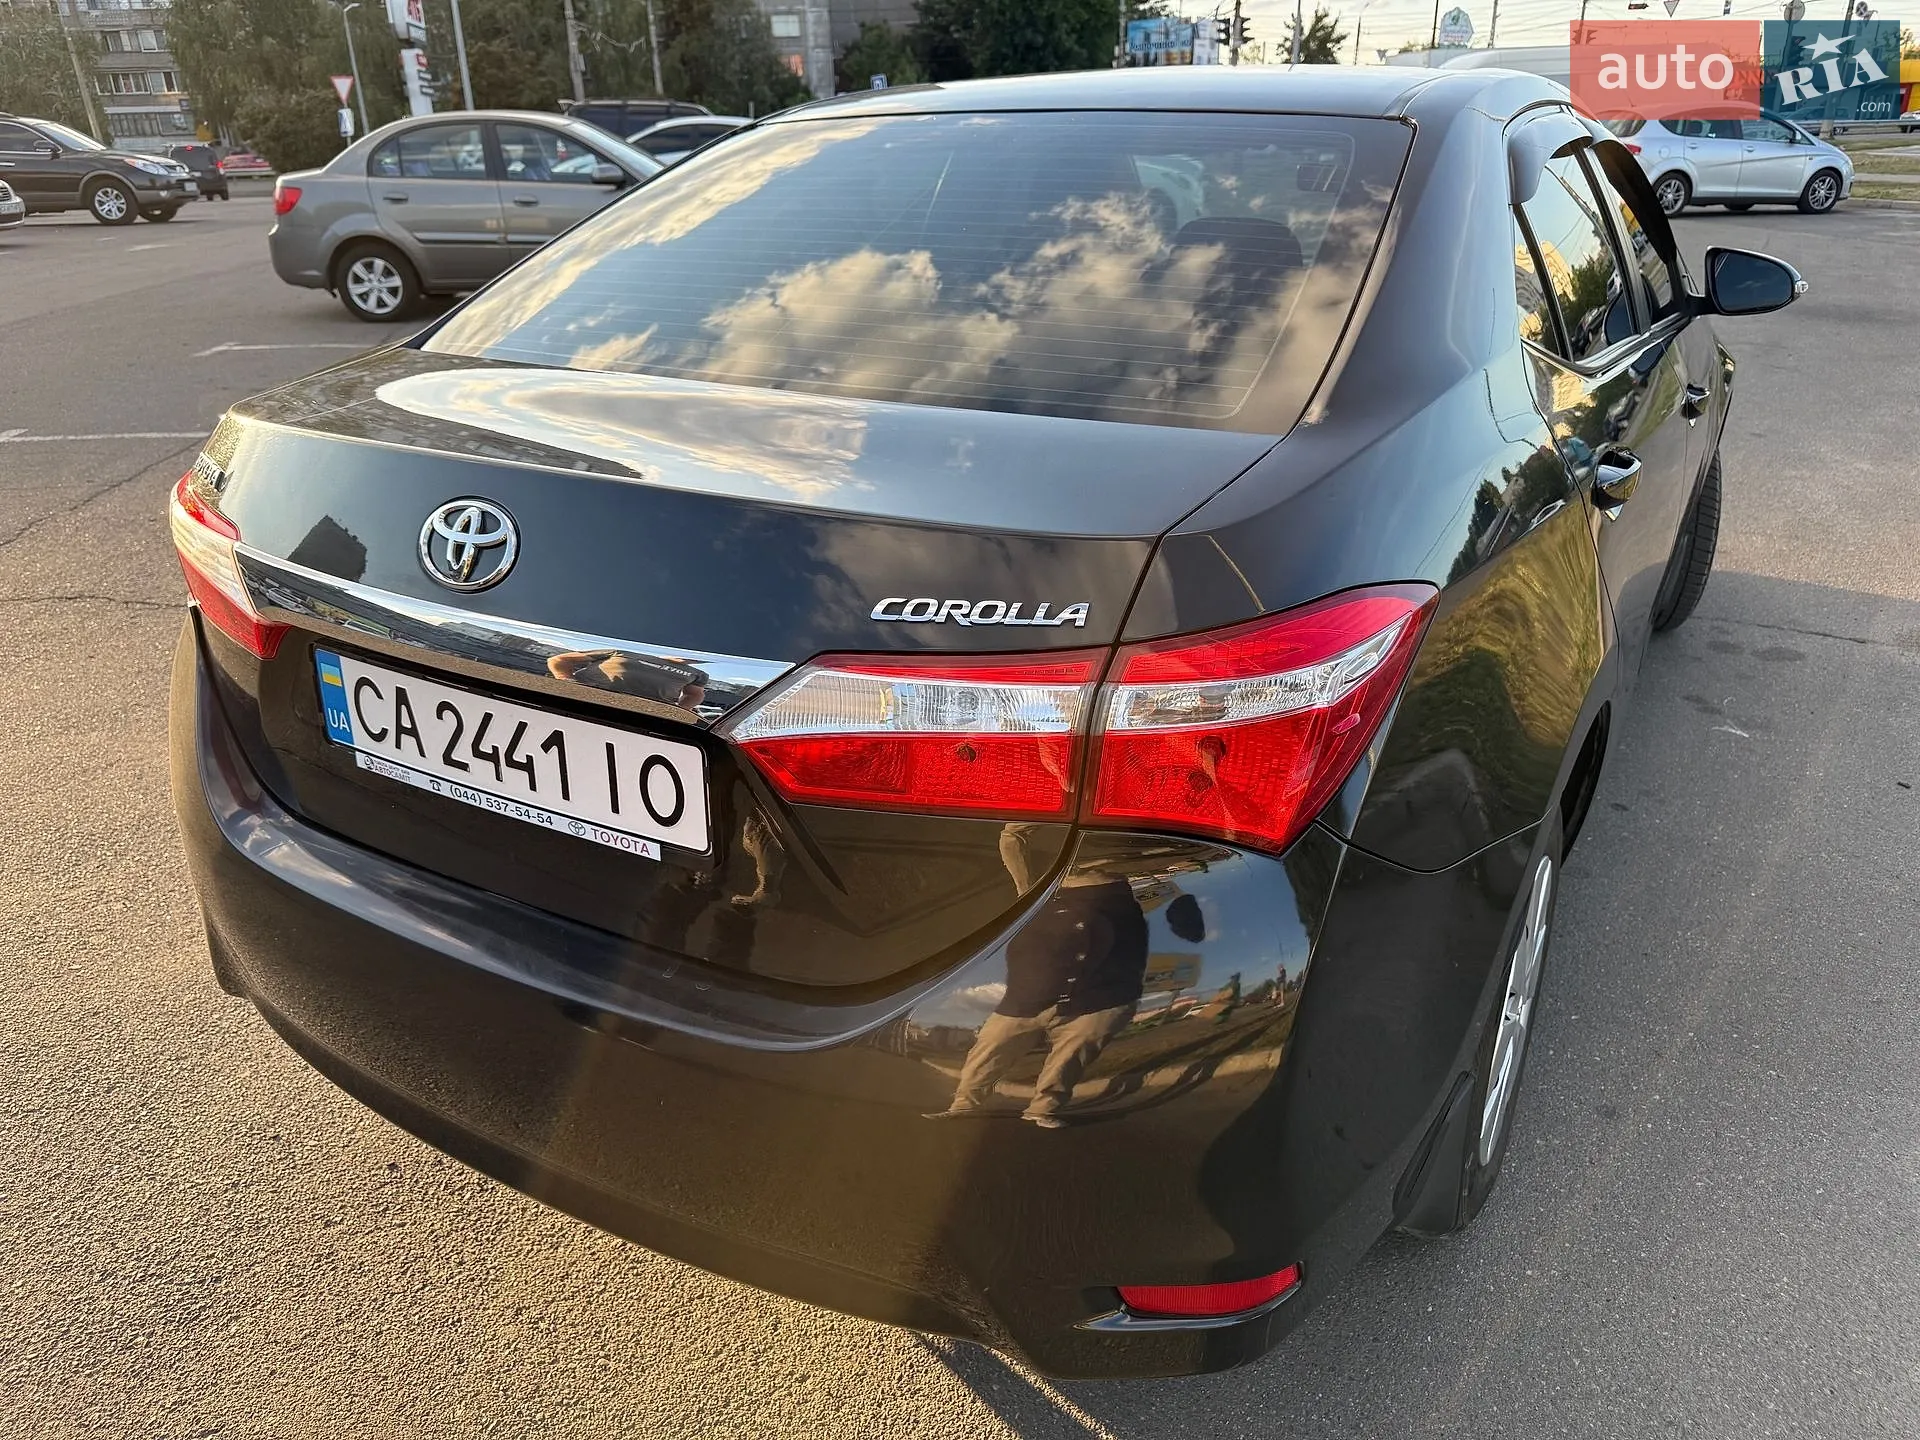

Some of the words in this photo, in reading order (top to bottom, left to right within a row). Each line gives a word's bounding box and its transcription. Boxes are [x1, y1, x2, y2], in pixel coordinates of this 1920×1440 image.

[870, 597, 1090, 628] COROLLA
[328, 707, 350, 733] UA
[353, 676, 426, 758] CA
[435, 700, 570, 802] 2441
[449, 784, 483, 806] (044)
[486, 797, 554, 827] 537-54-54
[591, 827, 651, 856] TOYOTA
